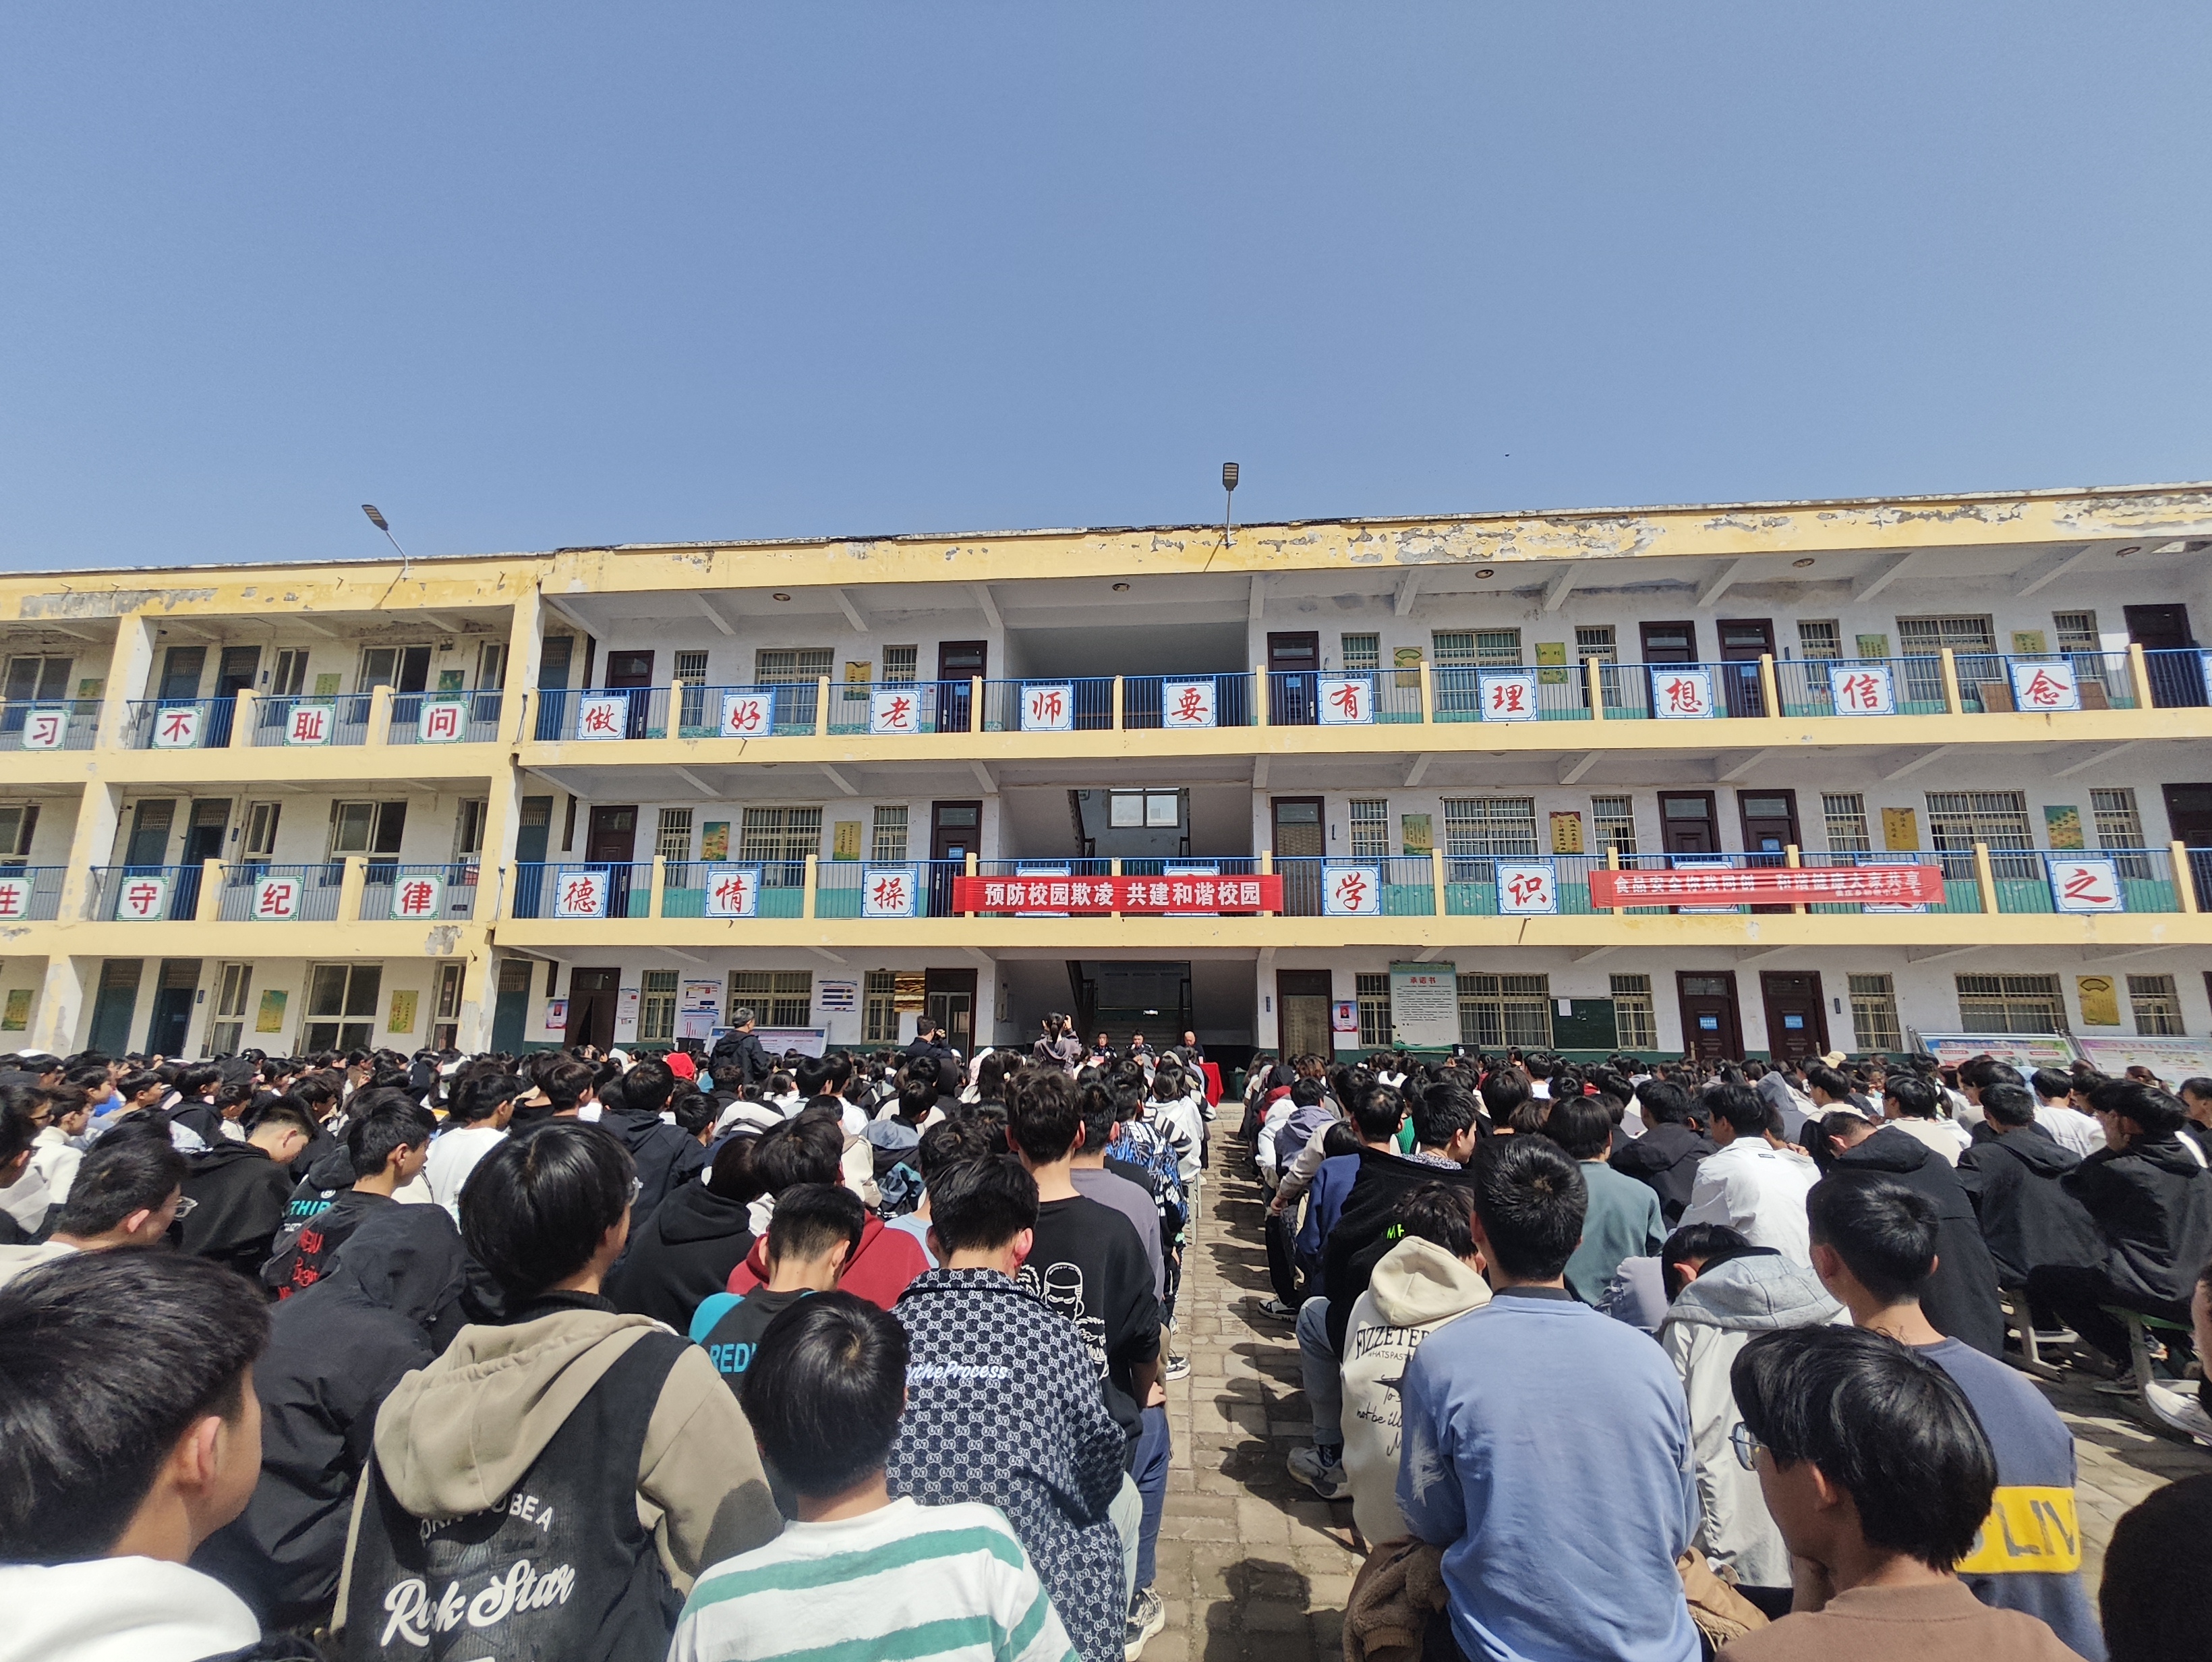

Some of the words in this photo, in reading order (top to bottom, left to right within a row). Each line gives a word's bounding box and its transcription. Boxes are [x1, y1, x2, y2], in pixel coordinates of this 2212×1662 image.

[585, 704, 618, 733] 做
[731, 700, 761, 730] 好
[880, 697, 910, 728] 老
[1032, 692, 1062, 725] 师
[1171, 687, 1209, 722] 要
[1329, 683, 1362, 719] 有
[1492, 684, 1524, 712] 理
[1664, 678, 1703, 713] 想
[1843, 674, 1880, 708] 信
[2024, 669, 2069, 705] 念
[33, 717, 59, 745] 习
[163, 714, 191, 741] 不
[293, 712, 324, 741] 耻
[428, 708, 458, 737] 问
[129, 884, 157, 915] 守
[262, 884, 291, 915] 纪
[401, 881, 434, 915] 律
[564, 876, 597, 913] 德
[715, 876, 747, 912] 情
[873, 877, 906, 911] 操
[985, 882, 1114, 907] 预防校园欺凌
[1126, 882, 1260, 906] 共建和谐校园
[1335, 871, 1368, 911] 学
[1507, 873, 1547, 907] 识
[2064, 868, 2112, 904] 之
[709, 1342, 757, 1373] RED
